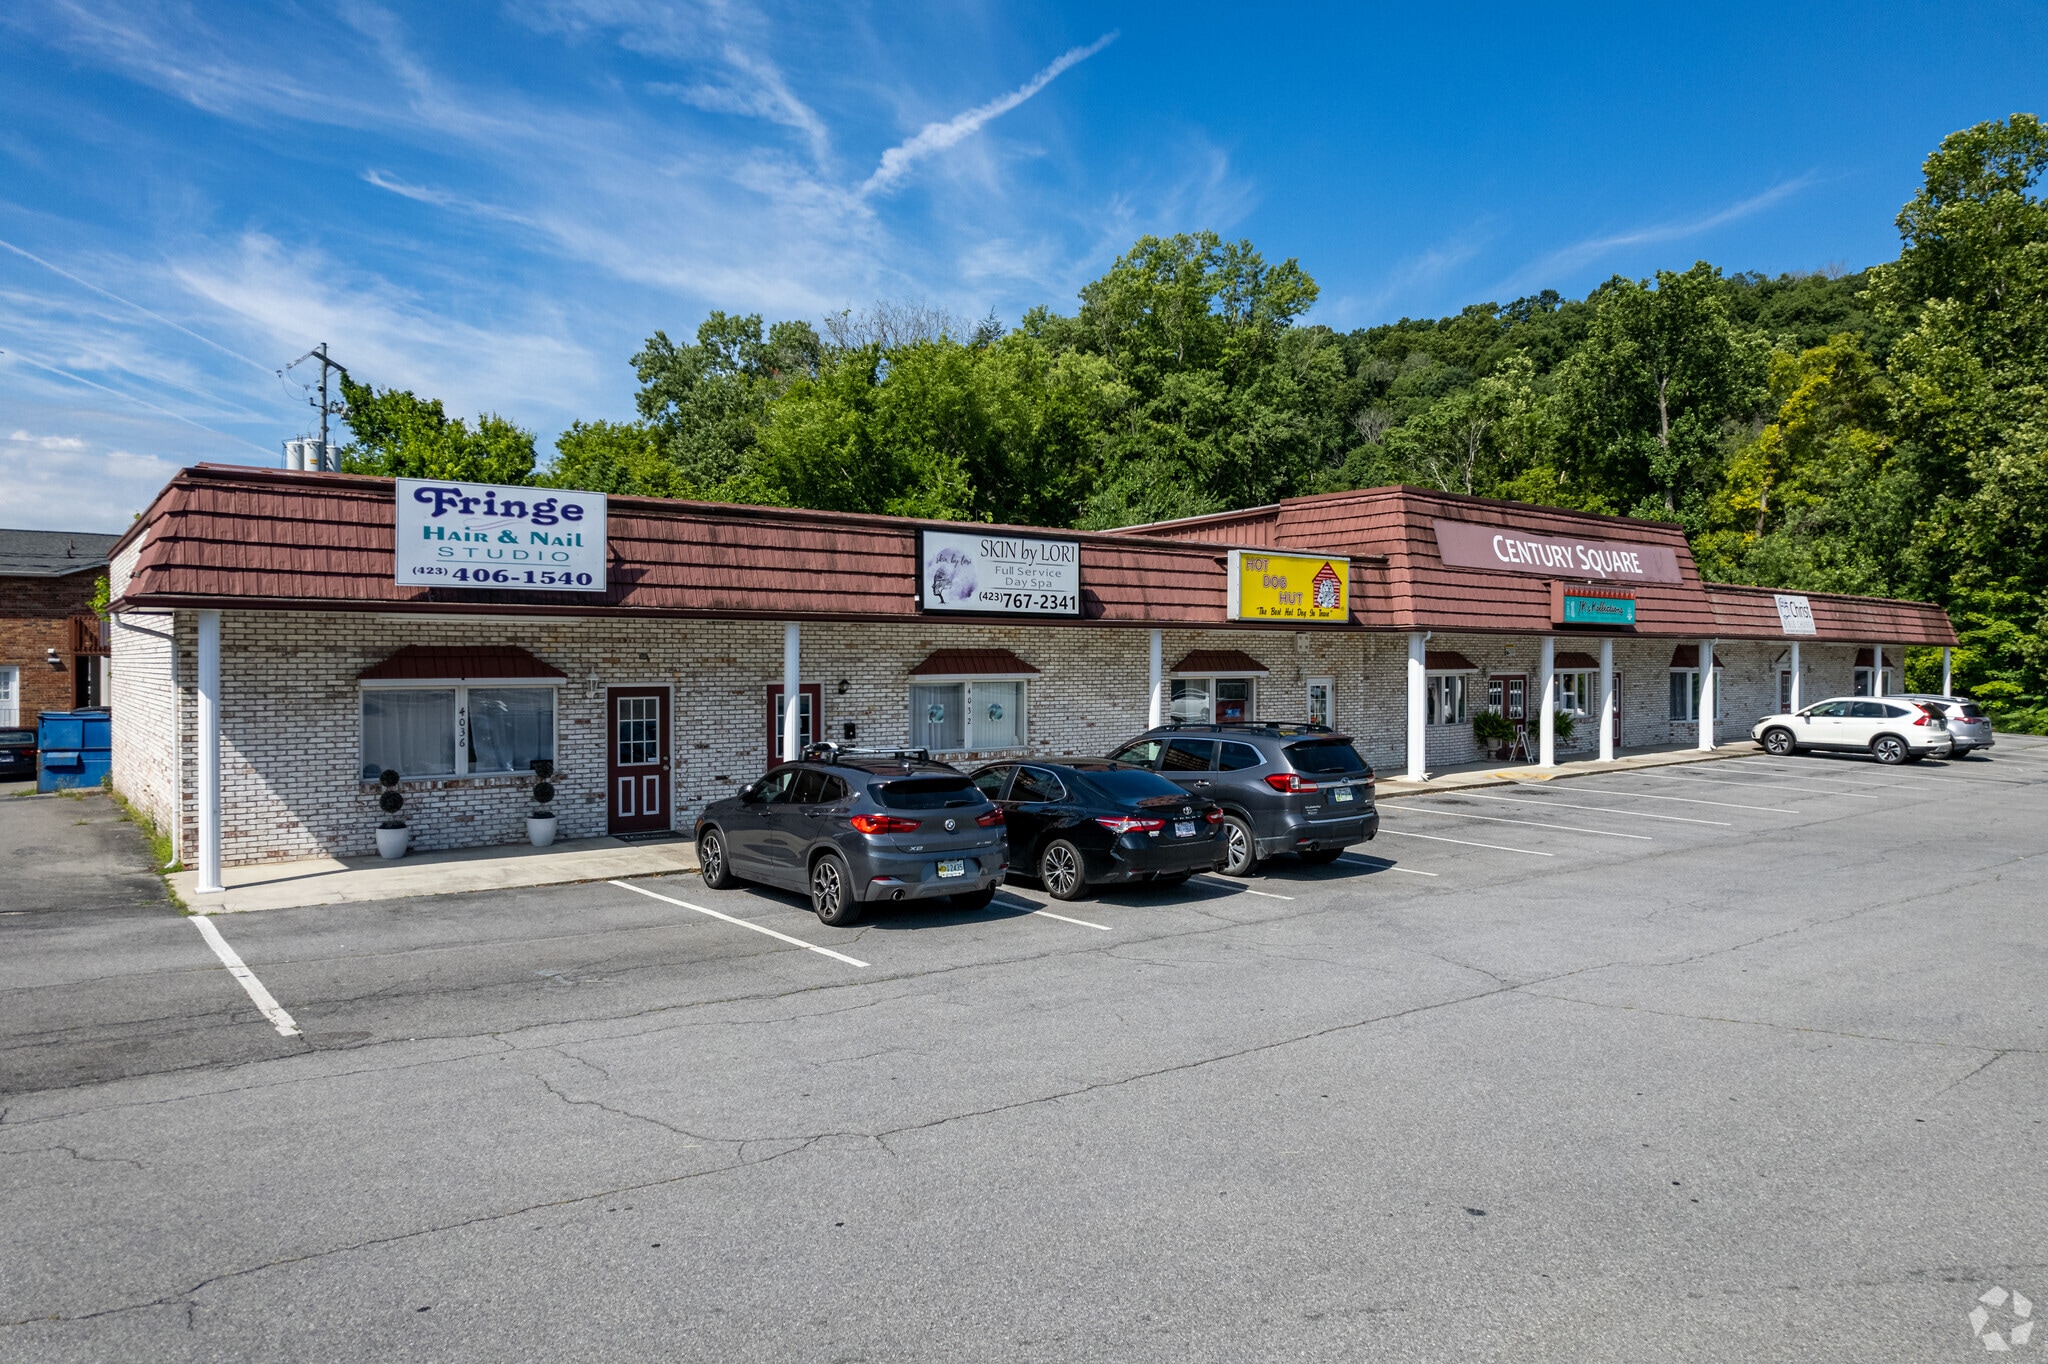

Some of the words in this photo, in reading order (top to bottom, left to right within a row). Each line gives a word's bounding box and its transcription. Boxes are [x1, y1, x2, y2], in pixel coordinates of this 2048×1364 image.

[414, 487, 584, 526] Fringe
[423, 526, 489, 543] Hair
[498, 530, 519, 544] &
[530, 531, 584, 548] Nail
[438, 546, 570, 562] STUDIO
[980, 539, 1017, 559] SKIN
[1021, 540, 1038, 566] by
[1040, 544, 1075, 563] LORI
[995, 566, 1014, 576] Full
[1017, 567, 1062, 578] Service
[1245, 557, 1270, 572] HOT
[412, 566, 448, 576] (423)
[452, 568, 593, 586] 406-1540
[1005, 577, 1028, 589] Day
[1030, 578, 1053, 590] Spa
[1263, 574, 1287, 590] DOG
[978, 591, 1004, 603] (423)
[1003, 593, 1076, 610] 767-2341
[1279, 591, 1303, 605] HUT
